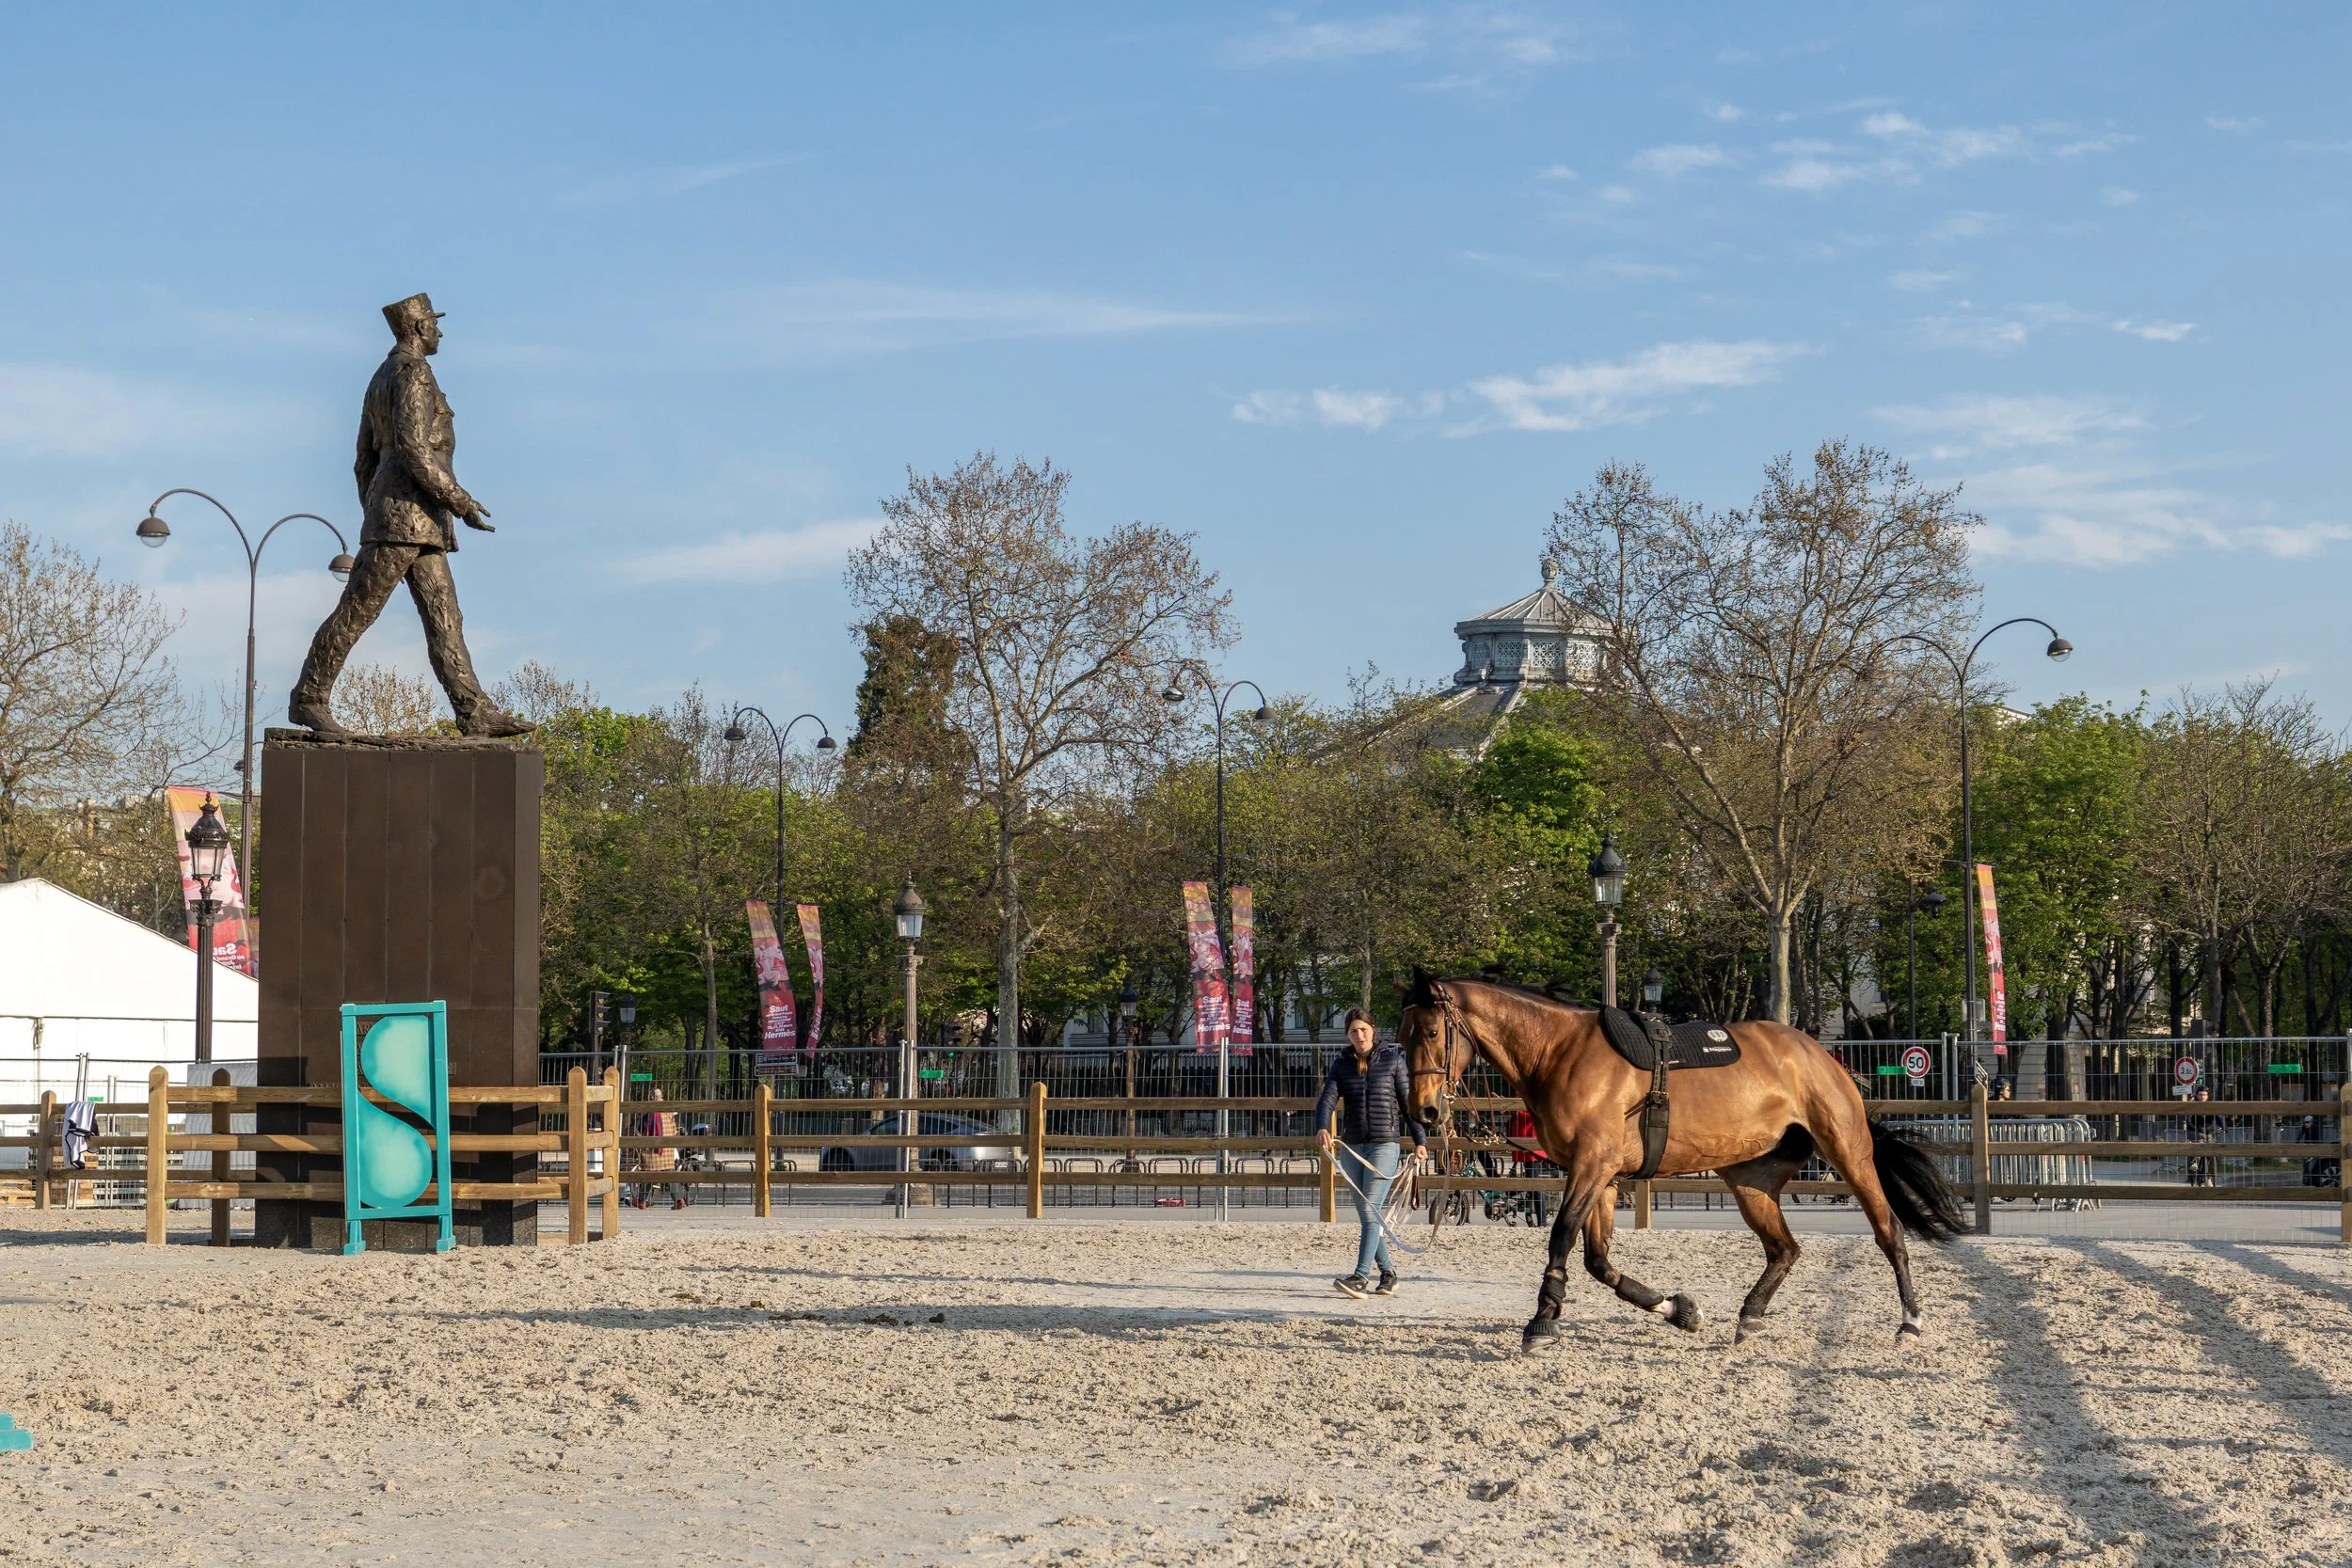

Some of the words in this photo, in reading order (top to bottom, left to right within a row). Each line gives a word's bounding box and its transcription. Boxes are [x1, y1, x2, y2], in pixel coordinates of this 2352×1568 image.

[1203, 995, 1223, 1004] Saut
[769, 1005, 788, 1013] Saut
[1197, 1022, 1231, 1032] Hermès
[764, 1029, 796, 1039] Hermès
[1908, 1056, 1924, 1069] 50
